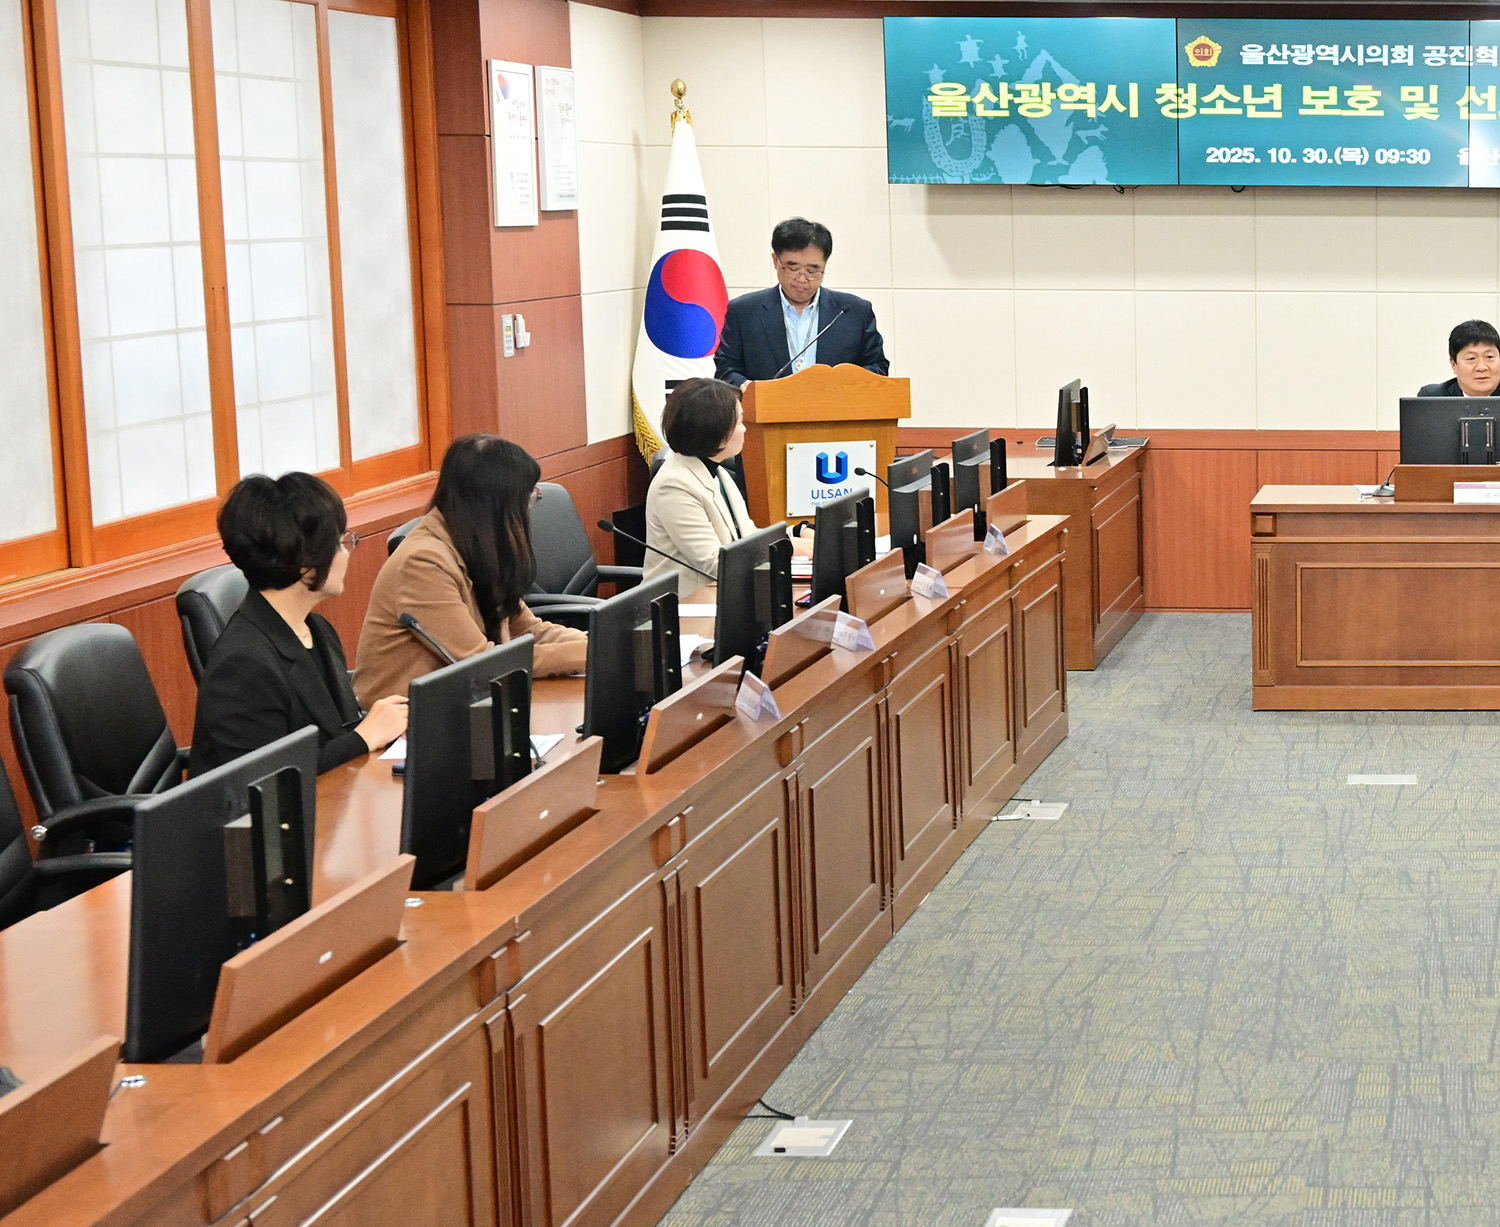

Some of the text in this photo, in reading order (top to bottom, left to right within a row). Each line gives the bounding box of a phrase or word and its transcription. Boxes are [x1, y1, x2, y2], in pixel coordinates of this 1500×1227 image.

[1239, 43, 1415, 67] 울산광역시의회
[1422, 44, 1499, 68] 공진혁
[926, 81, 1139, 119] 울산광역시
[1154, 81, 1283, 120] 청소년
[1298, 83, 1385, 119] 보호
[1400, 84, 1441, 121] 및
[1206, 146, 1261, 165] 2025.
[1267, 147, 1297, 165] 10.
[1302, 146, 1369, 167] 30.(목)
[1375, 148, 1431, 165] 09:30
